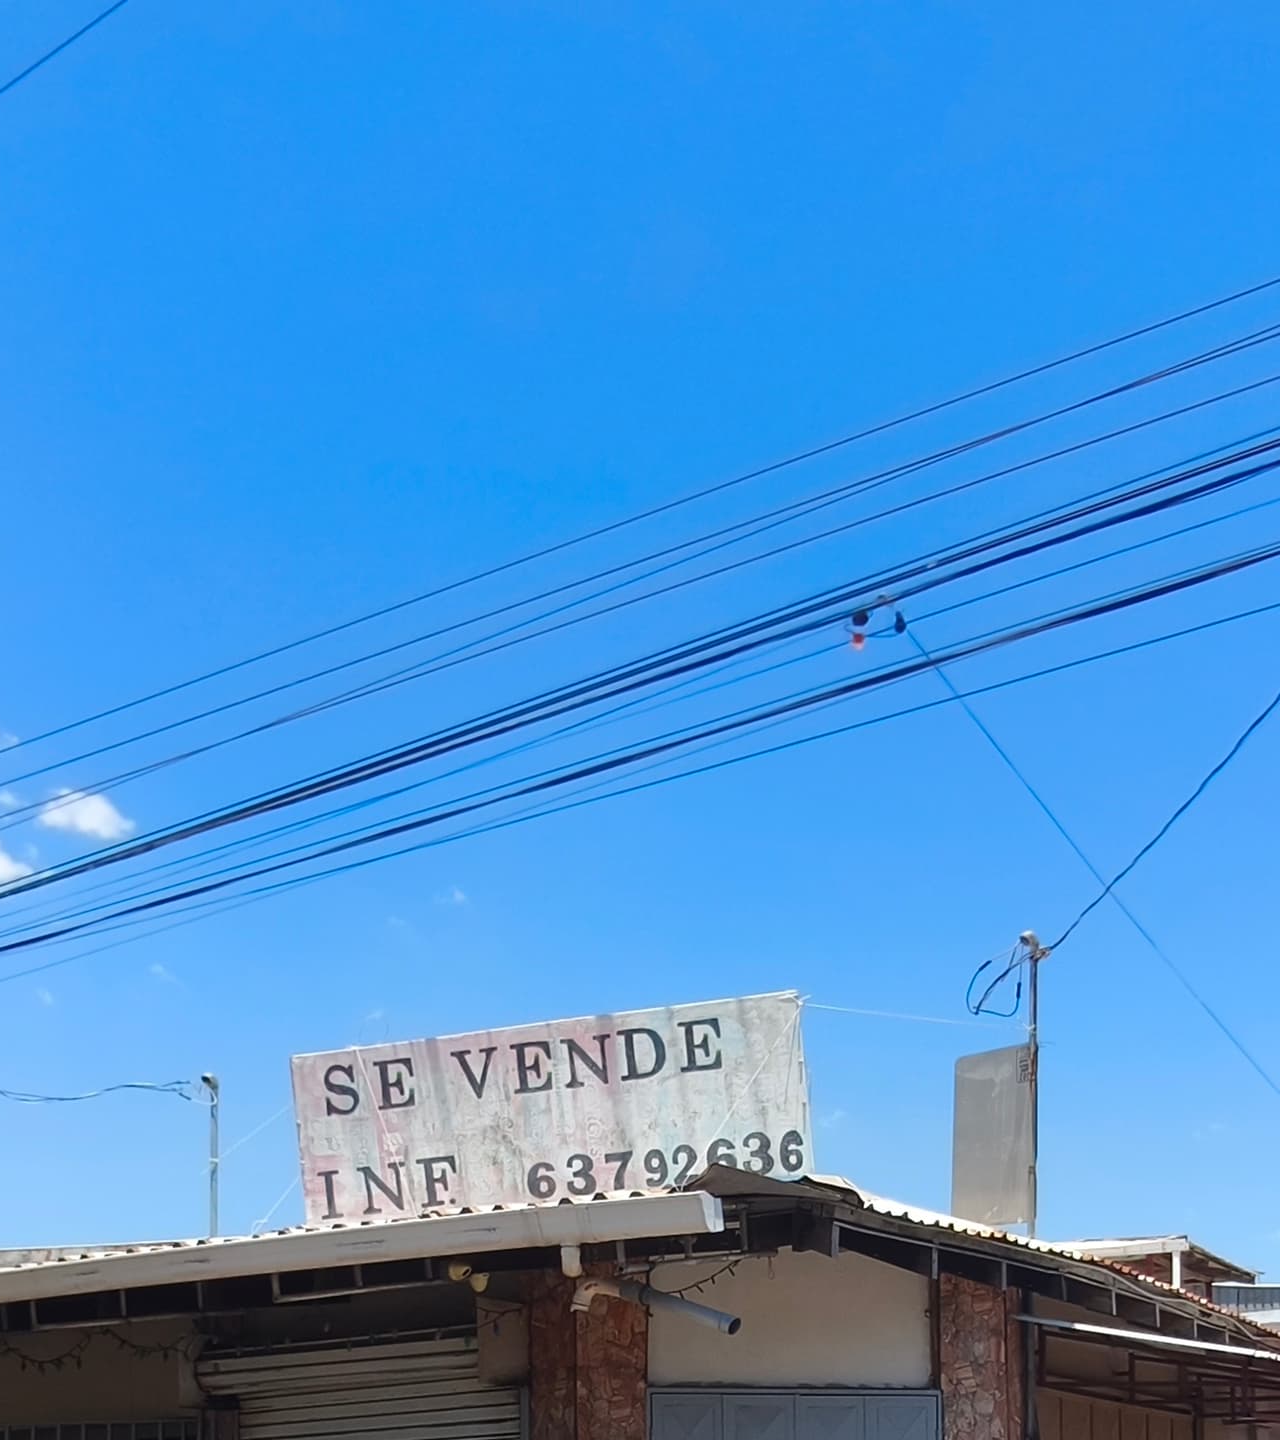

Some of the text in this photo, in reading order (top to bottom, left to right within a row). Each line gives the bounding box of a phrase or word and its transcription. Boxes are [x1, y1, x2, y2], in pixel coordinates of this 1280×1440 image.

[323, 1017, 723, 1117] SE VENDE
[317, 1129, 806, 1220] INF. 63792636
